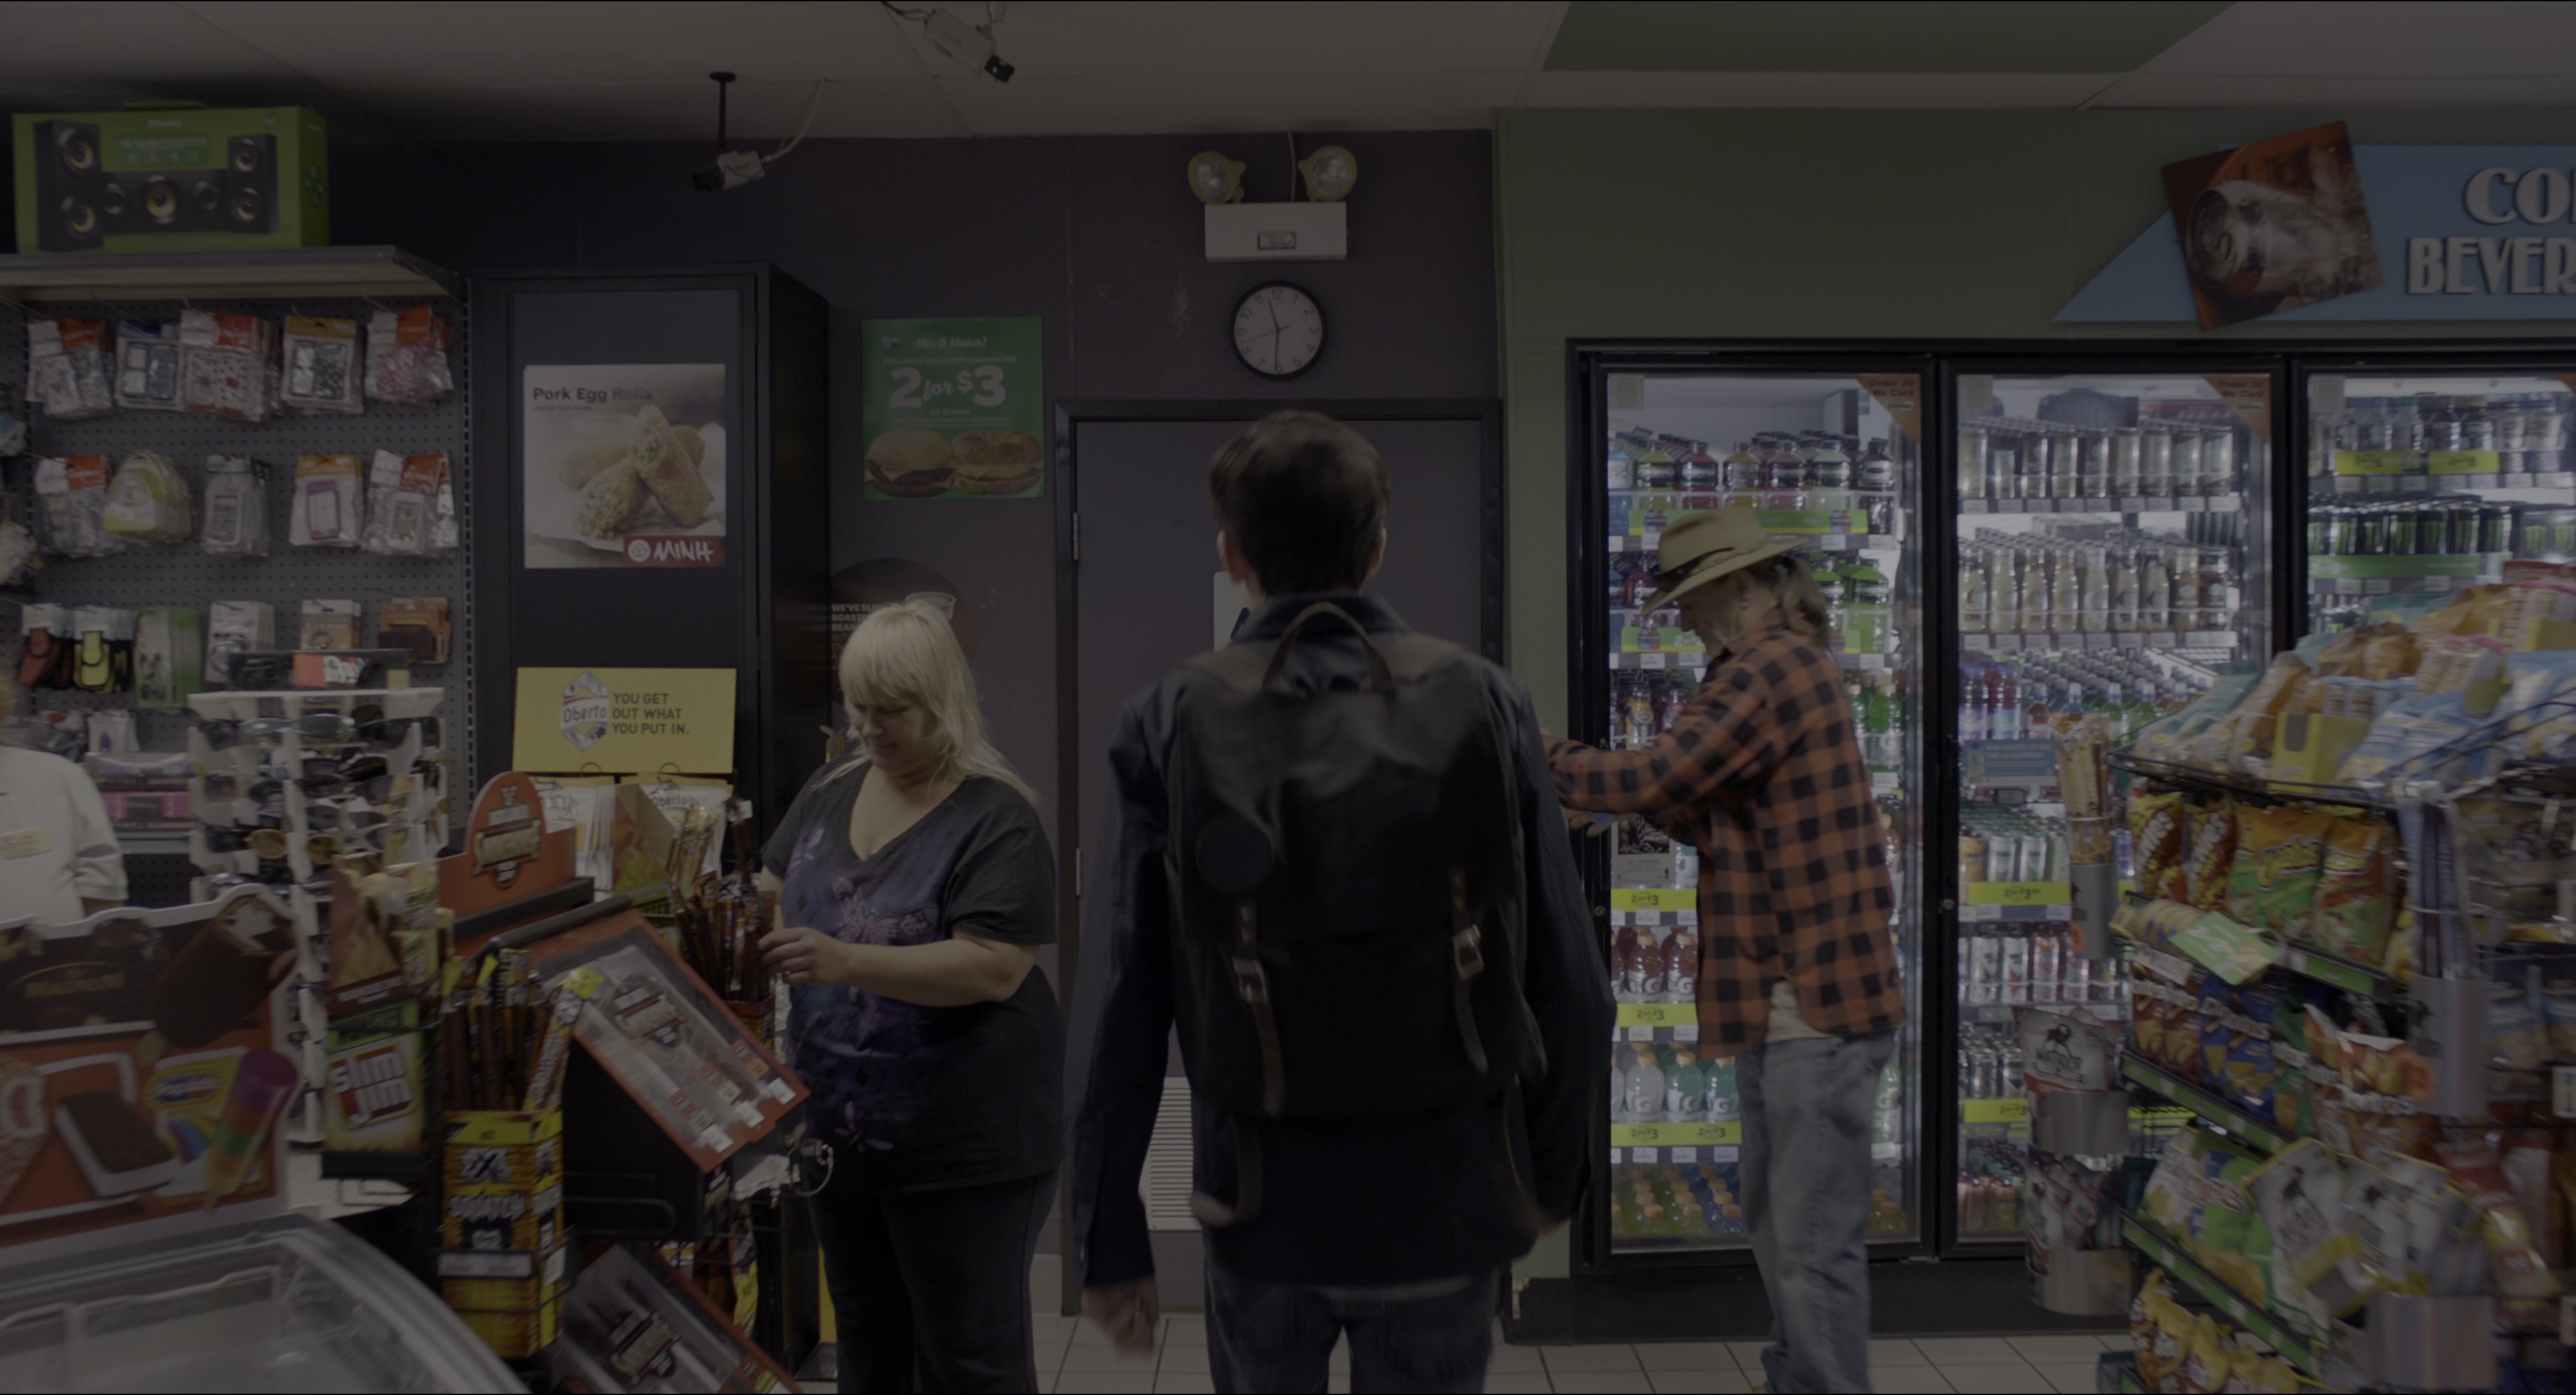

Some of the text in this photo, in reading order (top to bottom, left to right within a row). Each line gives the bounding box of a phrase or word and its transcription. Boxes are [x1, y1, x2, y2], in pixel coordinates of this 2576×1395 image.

[2463, 167, 2576, 225] CO
[2406, 237, 2576, 295] BEVER
[1272, 290, 1283, 300] 12
[1304, 307, 1316, 317] 2
[1309, 326, 1320, 334] 3
[889, 365, 1006, 408] 2 for $3
[533, 387, 653, 402] Pork Egg Rolls
[653, 539, 714, 563] MINH
[613, 693, 669, 704] YOU GET
[563, 706, 607, 723] Oberto
[612, 708, 682, 719] OUT WHAT
[612, 724, 690, 734] YOU PUT IN.
